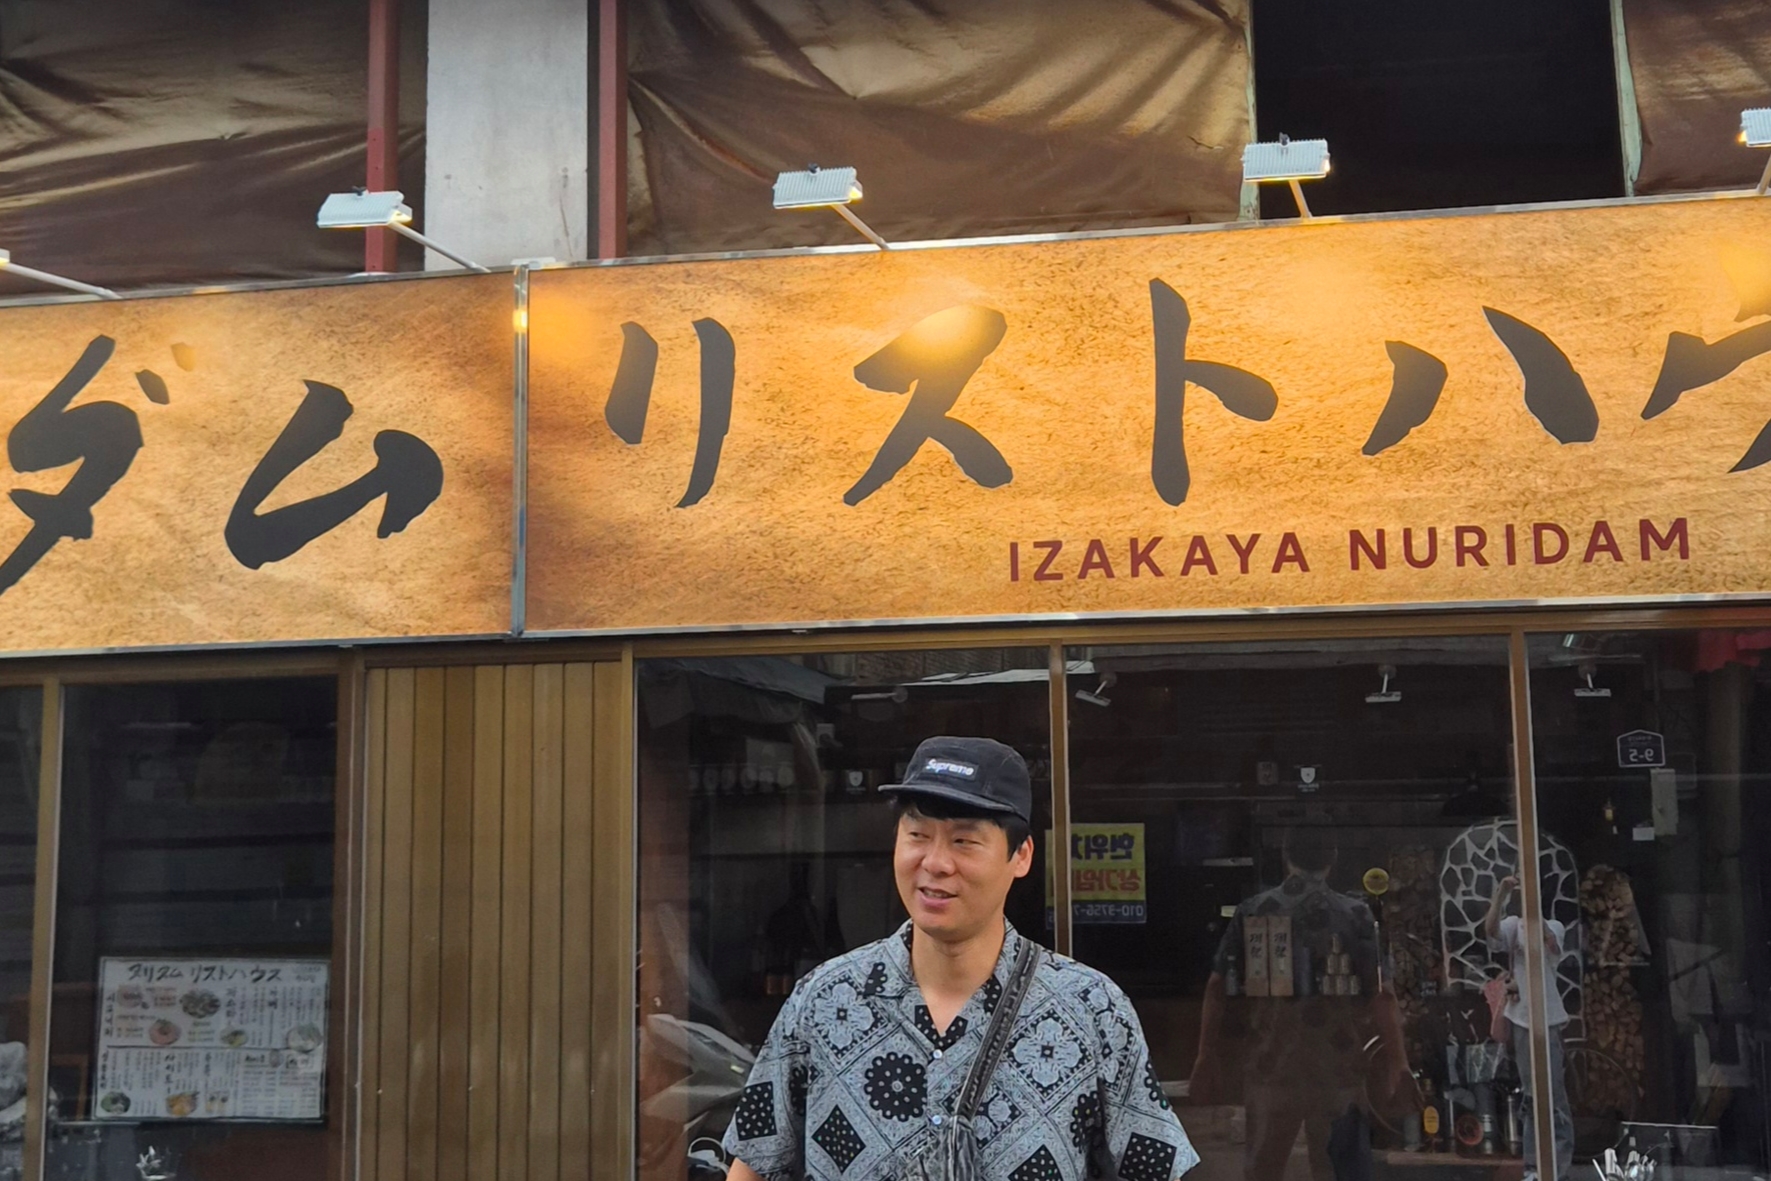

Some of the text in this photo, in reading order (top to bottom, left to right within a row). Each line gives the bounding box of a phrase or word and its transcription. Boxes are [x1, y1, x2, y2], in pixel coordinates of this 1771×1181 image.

[1010, 517, 1692, 582] IZAKAYA NURIDAM
[926, 758, 974, 775] Supreme
